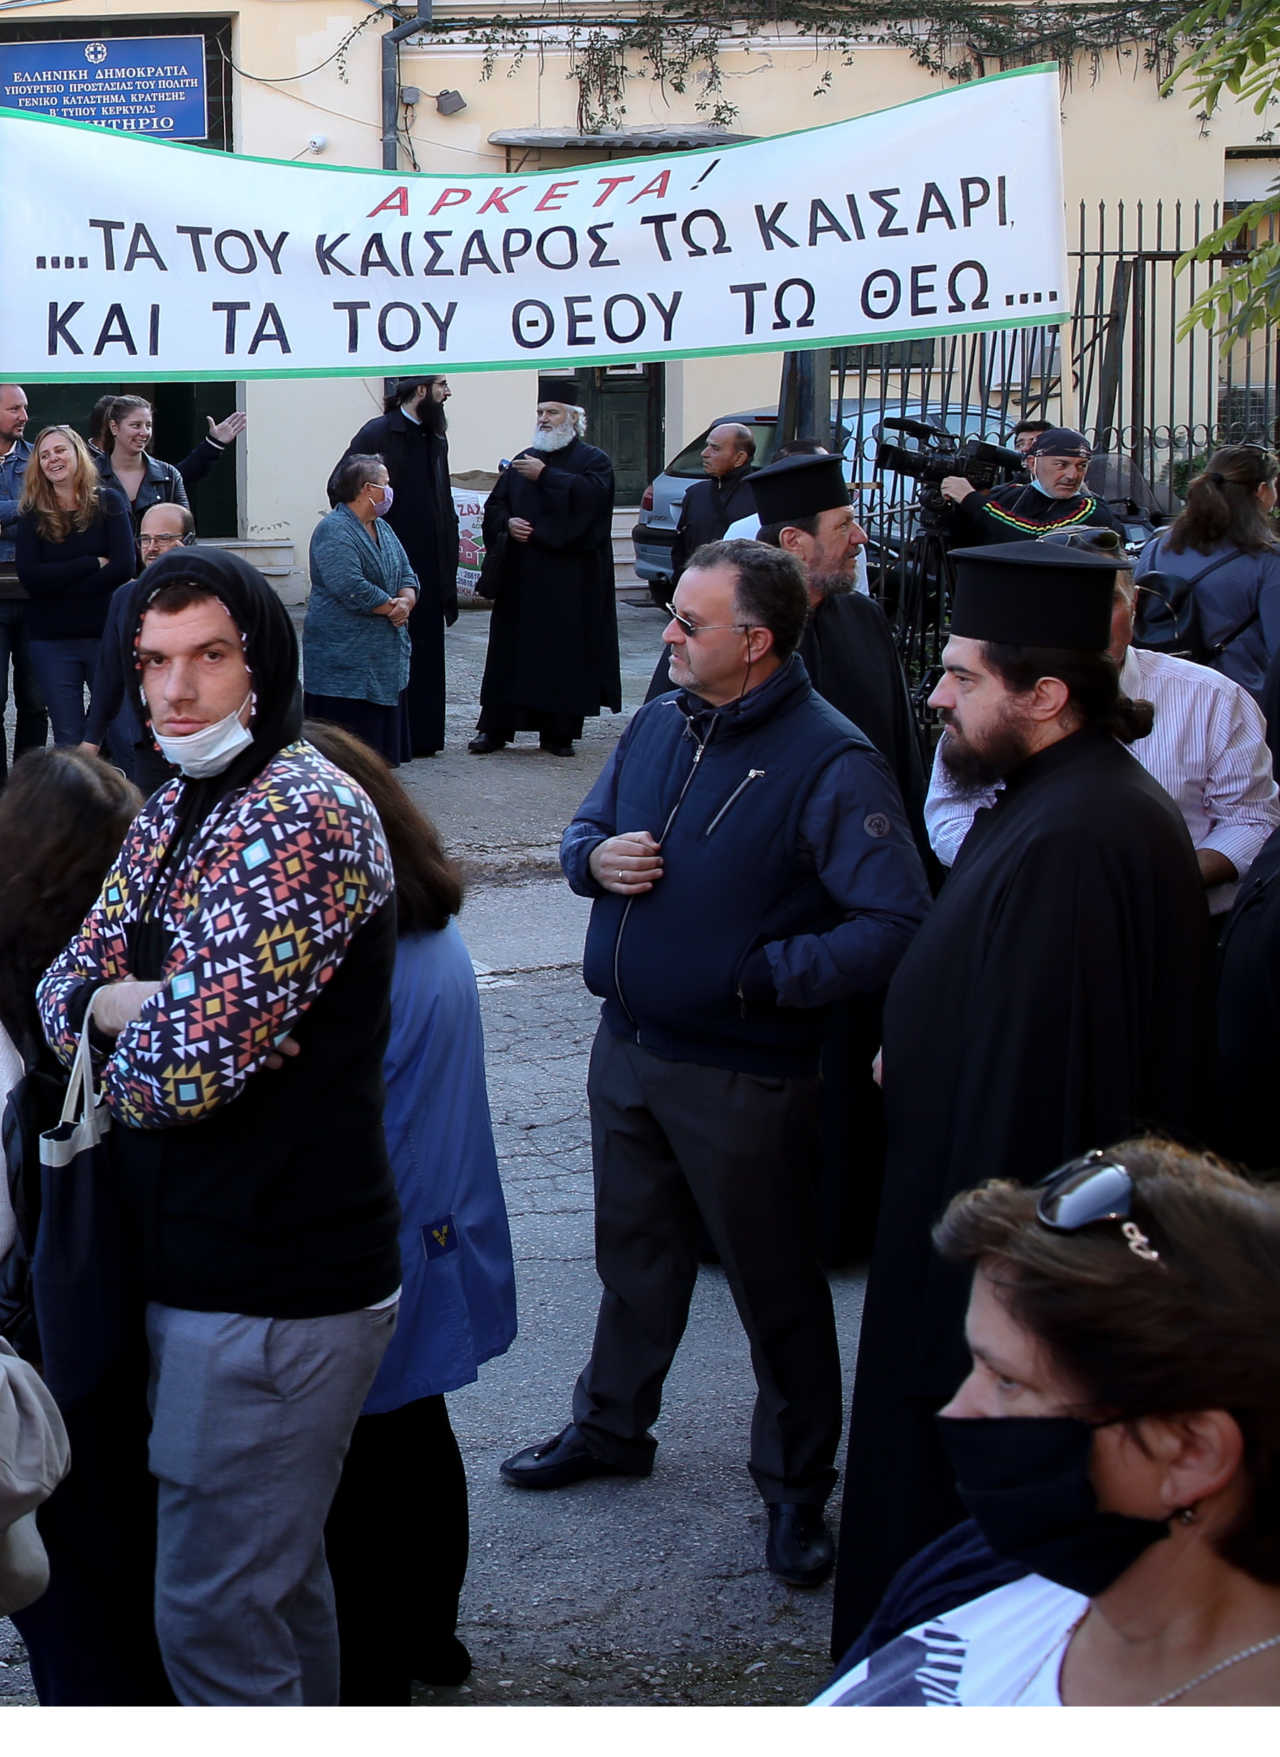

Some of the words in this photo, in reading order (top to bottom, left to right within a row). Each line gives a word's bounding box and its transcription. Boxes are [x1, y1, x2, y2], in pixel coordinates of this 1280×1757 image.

[13, 69, 88, 82] ΕΛΛΗΝΙΚΗ
[95, 65, 188, 79] ΔΗΜΟΚΡΑΤΙΑ
[4, 83, 65, 95] ΥΠΟΥΡΓΕΙΟ
[69, 81, 134, 92] ΠΡΟΣΤΑΣΙΑΣ
[135, 80, 156, 90] ΤΟΥ
[158, 78, 198, 88] ΠΟΛΙΤΗ
[18, 96, 58, 107] ΓΕΝΙΚΟ
[63, 94, 126, 105] ΚΑΤΑΣΤΗΜΑ
[130, 91, 186, 102] ΚΡΑΤΗΣΗΣ
[61, 107, 97, 117] ΤΥΠΟΥ
[101, 104, 156, 115] ΚΕΡΚΥΡΑΣ
[366, 158, 721, 218] ΑΡΚΕΤΑ!
[175, 224, 290, 275] ΤΟΥ
[316, 222, 621, 277] ΚΑΙΣΑΡΟΣ
[640, 209, 732, 262] ΤΩ
[754, 175, 1016, 251] ΚΑΙΣΑΡΙ,
[47, 301, 160, 356] ΚΑΙ
[212, 301, 292, 355] ΤΑ
[332, 301, 458, 354] ΤΟΥ
[511, 290, 683, 350] ΘΕΟΥ
[729, 277, 816, 335] ΤΩ
